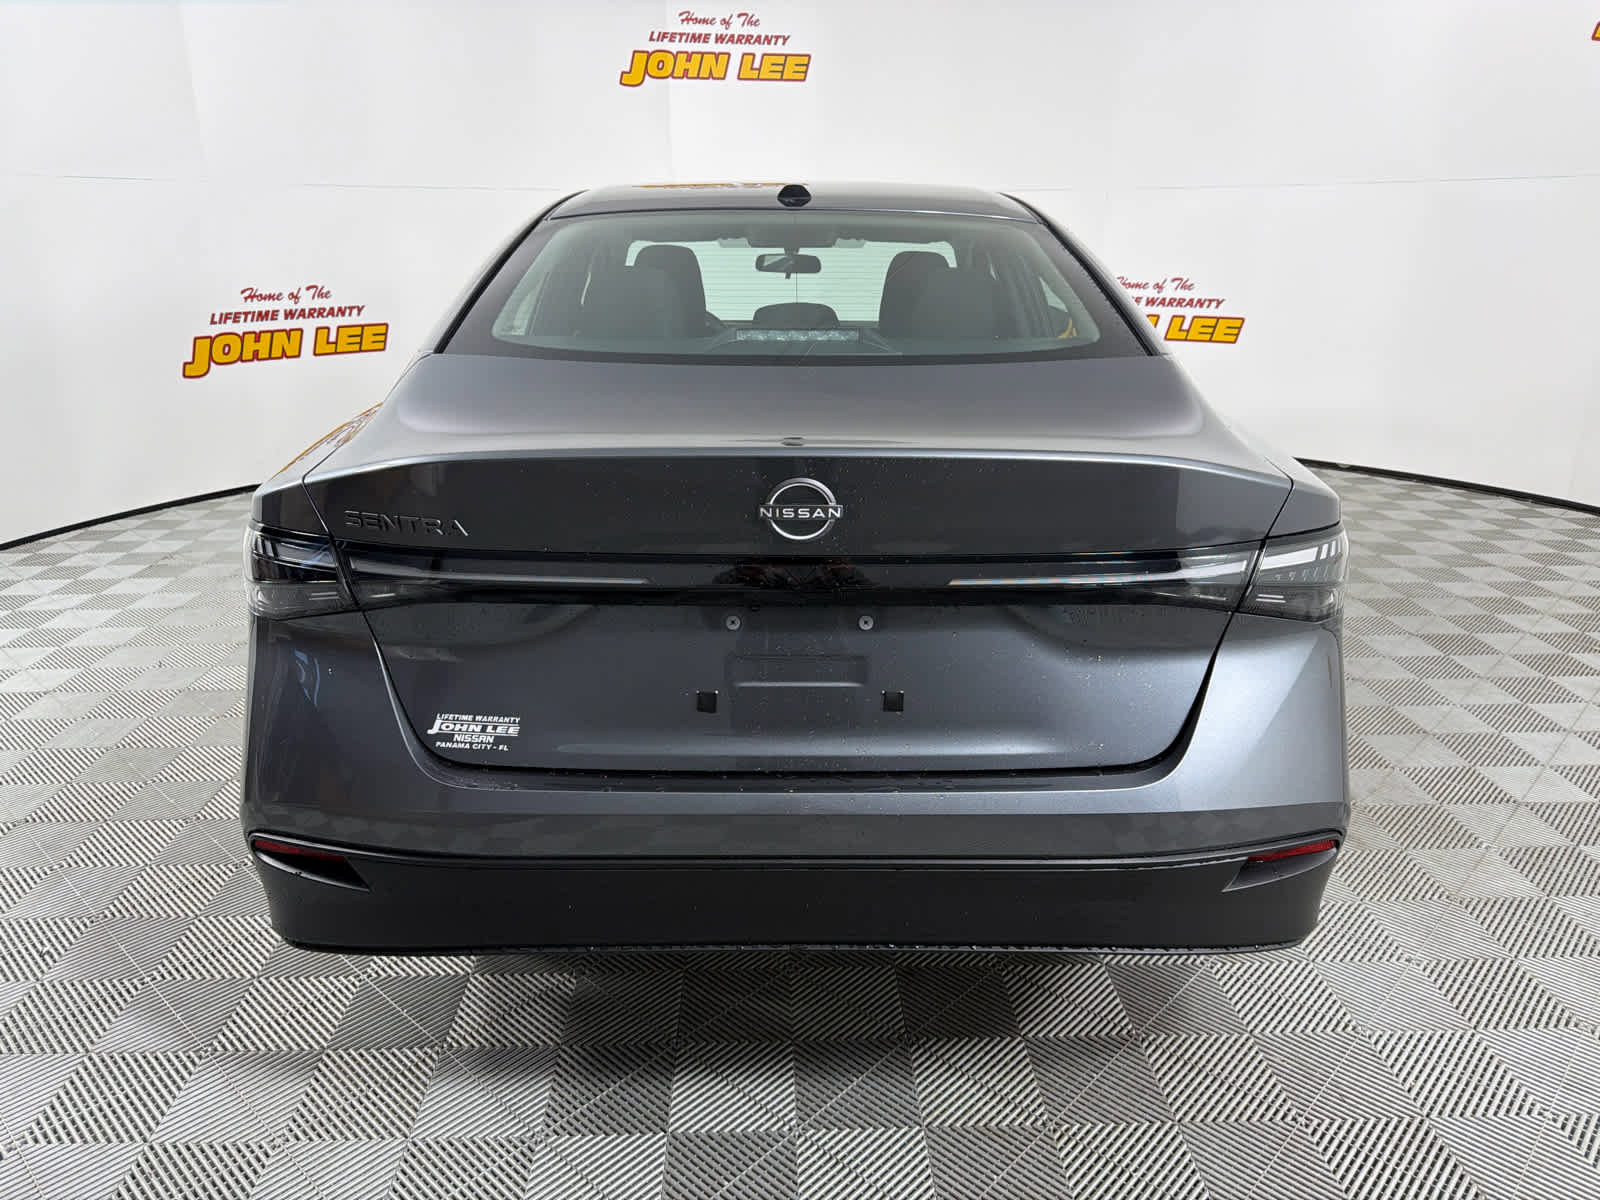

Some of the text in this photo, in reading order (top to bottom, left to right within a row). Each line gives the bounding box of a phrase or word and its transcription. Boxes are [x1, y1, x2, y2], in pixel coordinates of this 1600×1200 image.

[678, 11, 761, 30] Home of The
[648, 31, 790, 46] LIFETIME WARRANTY
[620, 50, 811, 87] JOHN LEE
[1152, 279, 1167, 294] of
[1171, 277, 1195, 291] The
[240, 285, 332, 304] Home of The
[1145, 296, 1226, 309] WARRANTY
[210, 305, 365, 325] LIFETIME WARRANTY
[1164, 315, 1245, 344] LEE
[182, 323, 388, 379] JOHN LEE
[760, 506, 841, 519] NISSAN
[344, 510, 469, 537] SENTRA
[426, 719, 520, 735] JOHN LEE
[436, 713, 520, 724] LIFETIME WARRANTY
[435, 741, 470, 750] PANAMA
[472, 743, 492, 751] CITY
[452, 734, 495, 743] NISSAN
